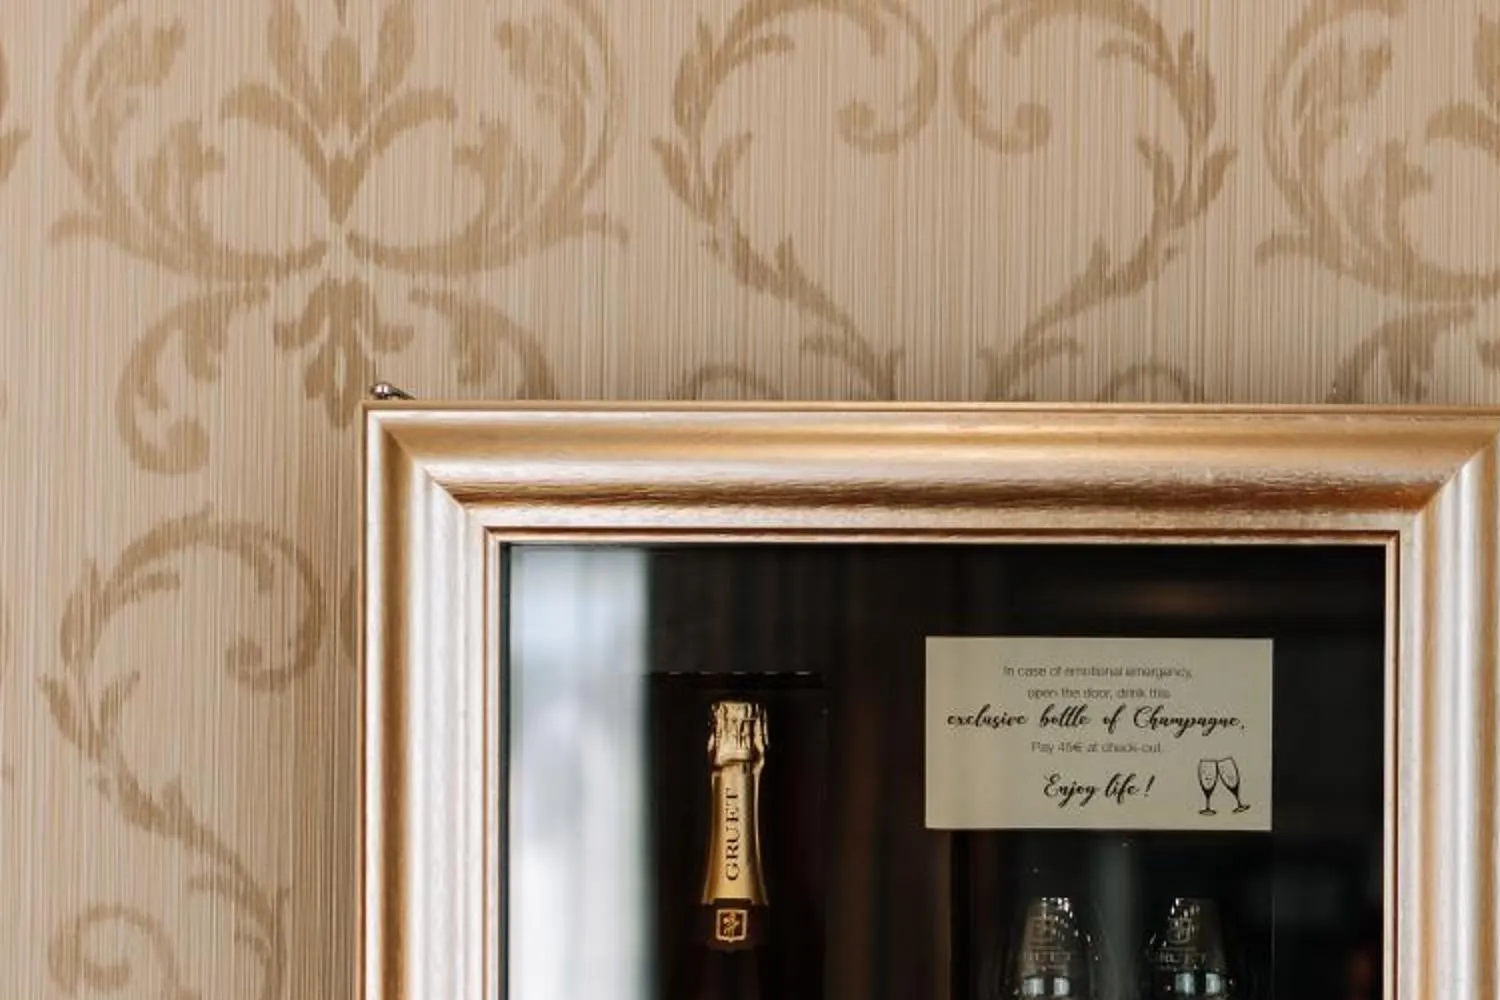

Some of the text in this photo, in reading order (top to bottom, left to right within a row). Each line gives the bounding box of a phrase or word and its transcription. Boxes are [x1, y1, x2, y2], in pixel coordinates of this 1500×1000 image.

[1003, 665, 1014, 677] In
[1018, 667, 1046, 677] case
[1050, 666, 1061, 677] of
[1064, 666, 1122, 677] emotional
[1027, 688, 1058, 700] open
[1061, 688, 1080, 698] the
[1083, 688, 1112, 700] door,
[1116, 688, 1145, 698] drink
[947, 703, 1027, 729] exclusive
[1039, 703, 1090, 728] bottle
[1102, 703, 1127, 735] of
[1031, 741, 1054, 754] Pay
[1087, 742, 1099, 752] at
[1043, 773, 1098, 808] Enjoy
[1104, 772, 1140, 805] life
[725, 787, 740, 880] GRUET
